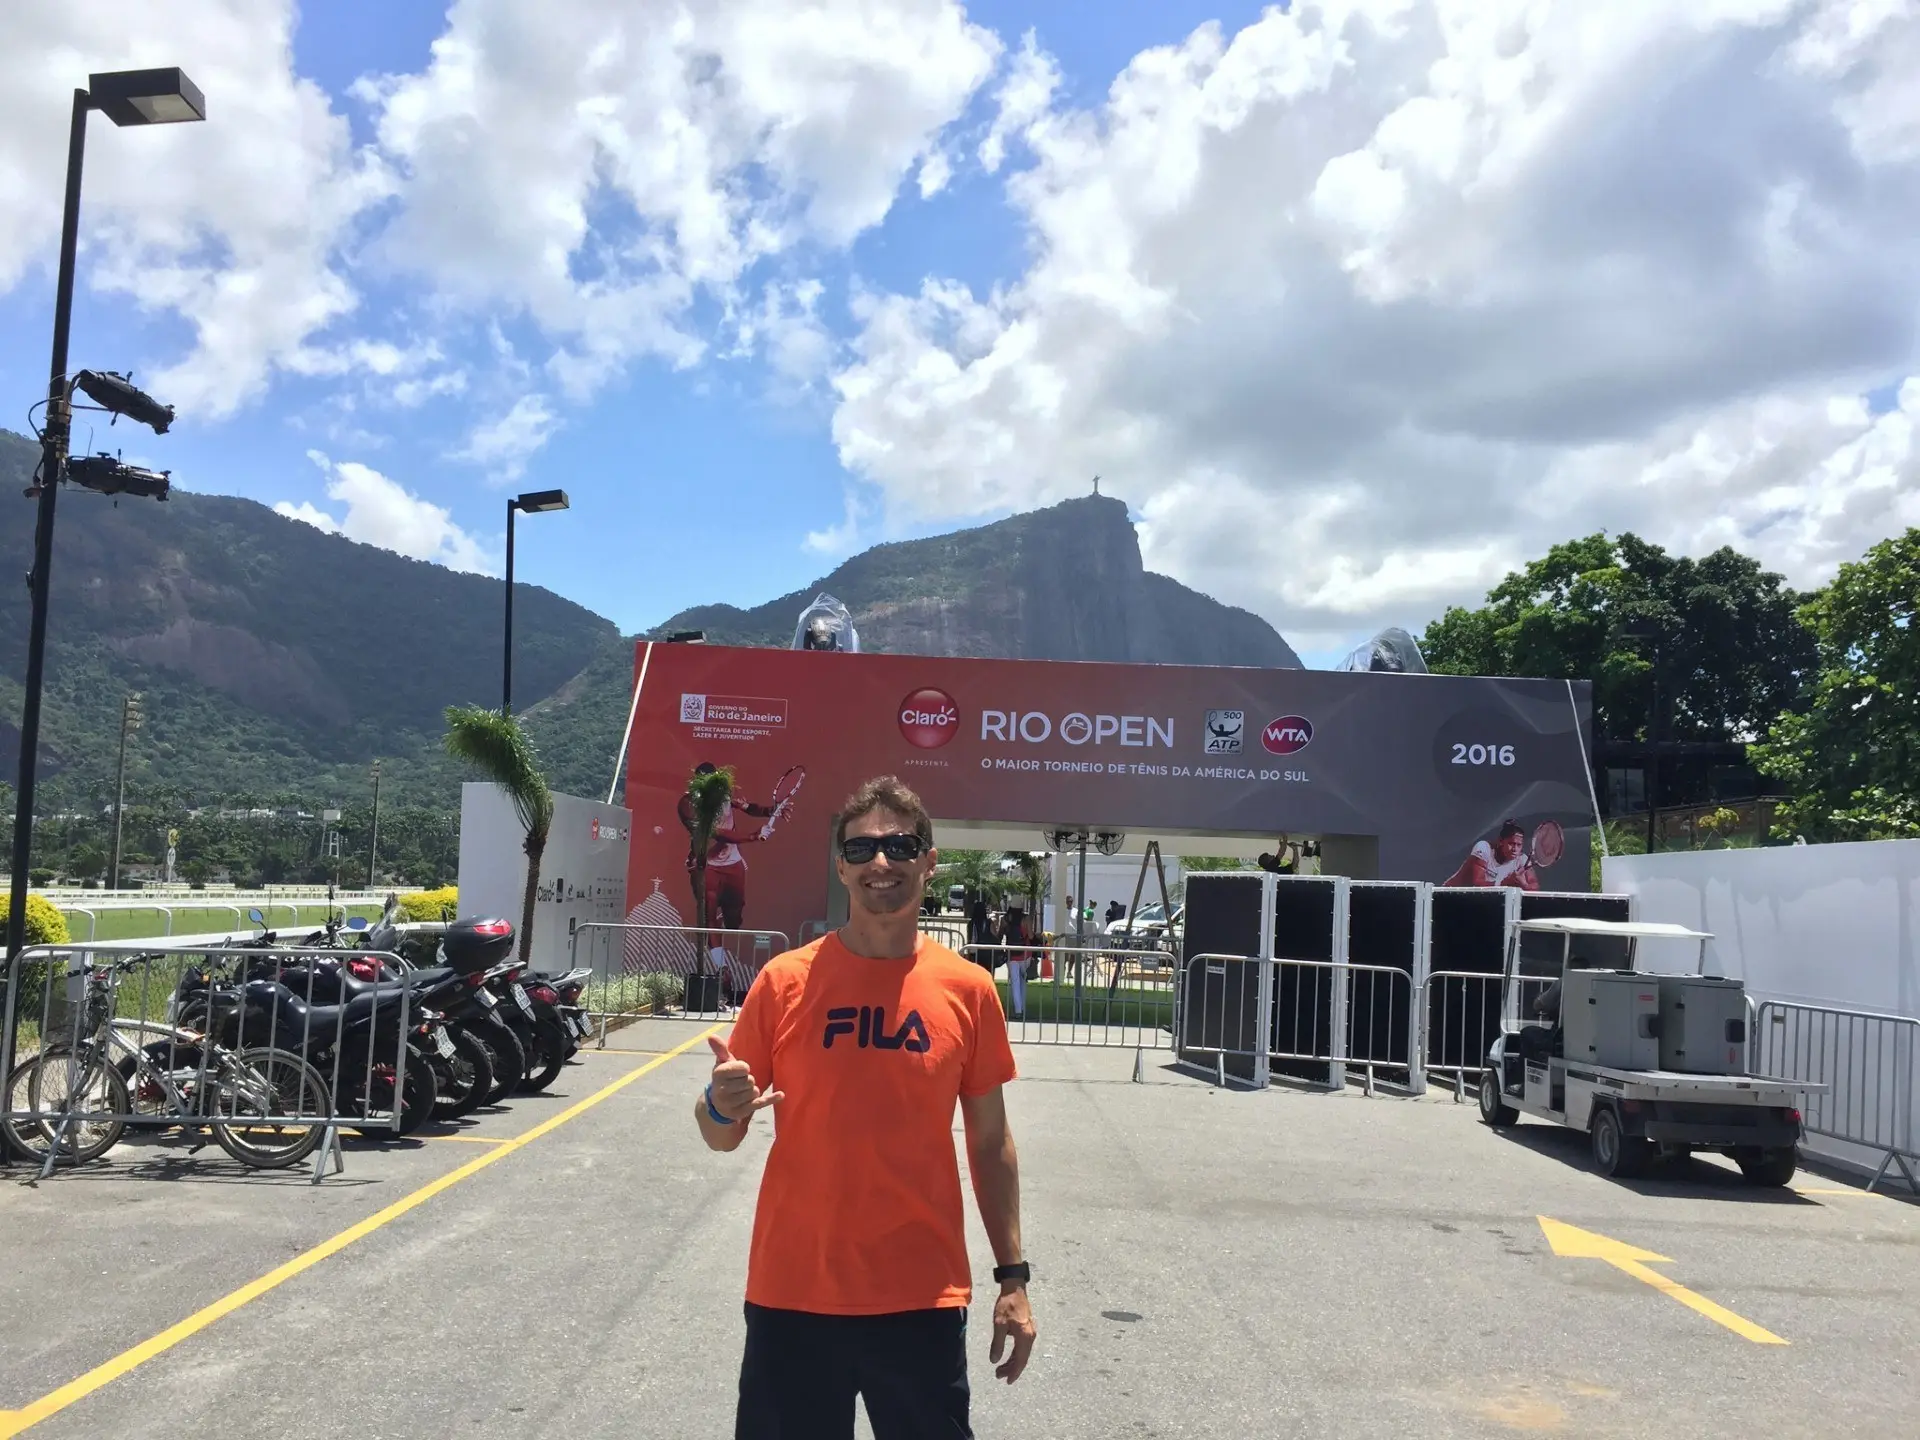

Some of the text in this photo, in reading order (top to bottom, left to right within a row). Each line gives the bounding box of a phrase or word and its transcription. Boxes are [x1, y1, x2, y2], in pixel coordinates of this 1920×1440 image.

[708, 704, 737, 712] GOVERNO
[707, 710, 782, 723] Rio de Janeiro
[901, 707, 950, 725] Claro
[1223, 711, 1242, 720] 500
[693, 725, 731, 734] SECRETARIA
[981, 710, 1174, 748] RIO OPEN
[1267, 728, 1309, 742] WTA
[1208, 739, 1240, 749] ATP
[1451, 743, 1516, 767] 2016
[981, 758, 1309, 782] O MAIOR TORNEIO DE TÊNIS DA AMÉRICA DO SUL
[823, 1006, 931, 1053] FILA
